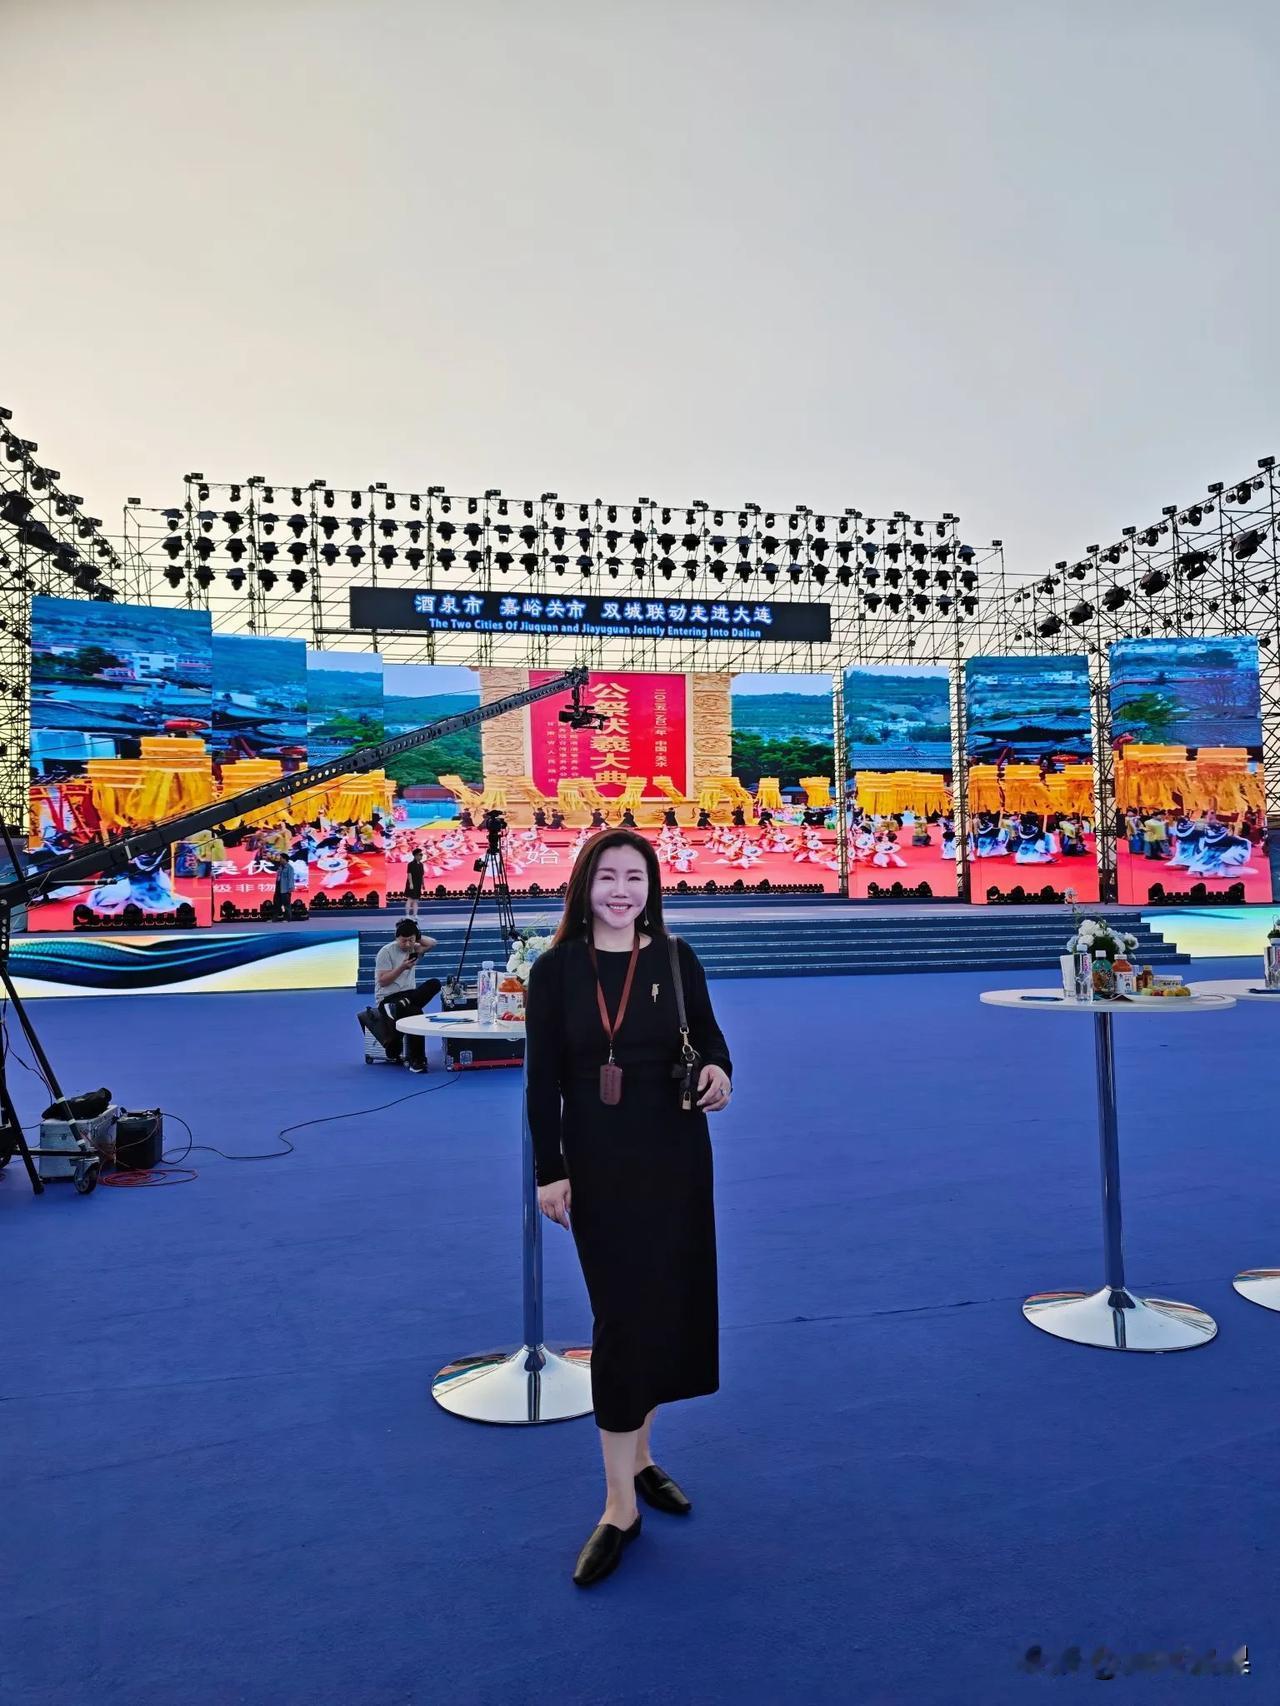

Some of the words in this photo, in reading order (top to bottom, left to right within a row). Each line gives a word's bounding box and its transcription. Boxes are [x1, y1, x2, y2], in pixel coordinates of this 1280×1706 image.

[415, 595, 484, 615] 酒泉市
[500, 597, 586, 619] 嘉峪关市
[601, 601, 773, 624] 双城联动走进大连
[430, 618, 448, 628] The
[451, 619, 471, 629] Two
[474, 619, 503, 630] Cities
[506, 620, 517, 630] Of
[520, 622, 558, 633] Jiuquan
[561, 623, 579, 633] and
[582, 623, 630, 635] Jiayuguan
[632, 625, 665, 636] Jointly
[667, 626, 707, 638] Entering
[710, 627, 729, 637] Into
[732, 628, 761, 638] Dalian
